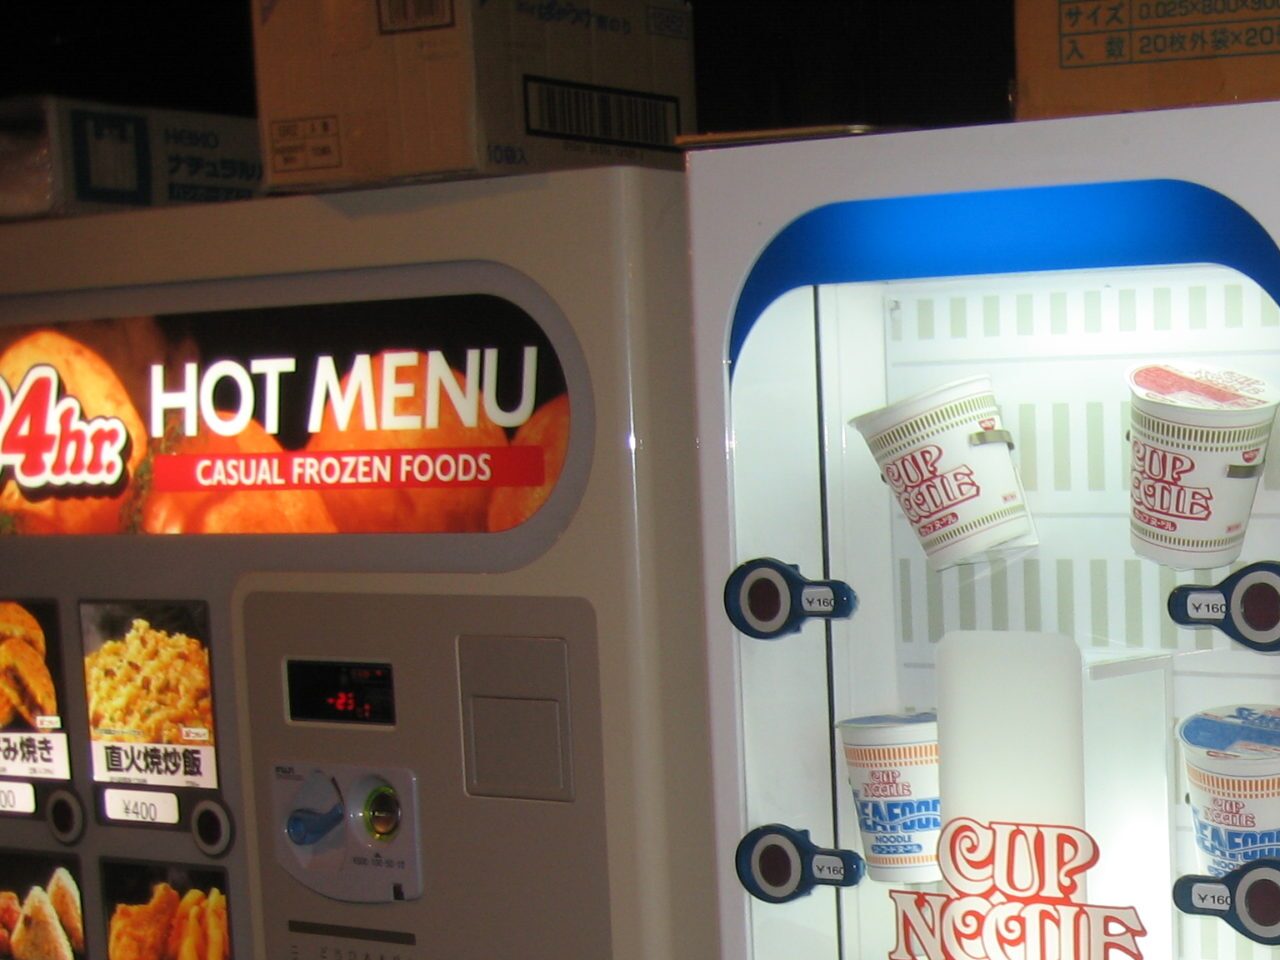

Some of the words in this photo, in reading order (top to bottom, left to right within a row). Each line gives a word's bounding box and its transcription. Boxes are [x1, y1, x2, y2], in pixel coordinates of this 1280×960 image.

[1065, 6, 1124, 27] サイズ
[150, 358, 296, 437] HOT
[308, 347, 538, 434] MENU
[196, 457, 285, 486] CASUAL
[292, 455, 391, 483] FROZEN
[401, 453, 491, 482] FOODS
[1131, 440, 1195, 486] CUP
[0, 736, 53, 763] み焼き
[105, 746, 203, 776] 直火焼炒飯
[870, 770, 901, 785] CUP
[123, 800, 158, 821] ¥400
[1213, 799, 1245, 814] CUP
[876, 835, 912, 843] NOODLE
[938, 817, 1100, 901] CUP
